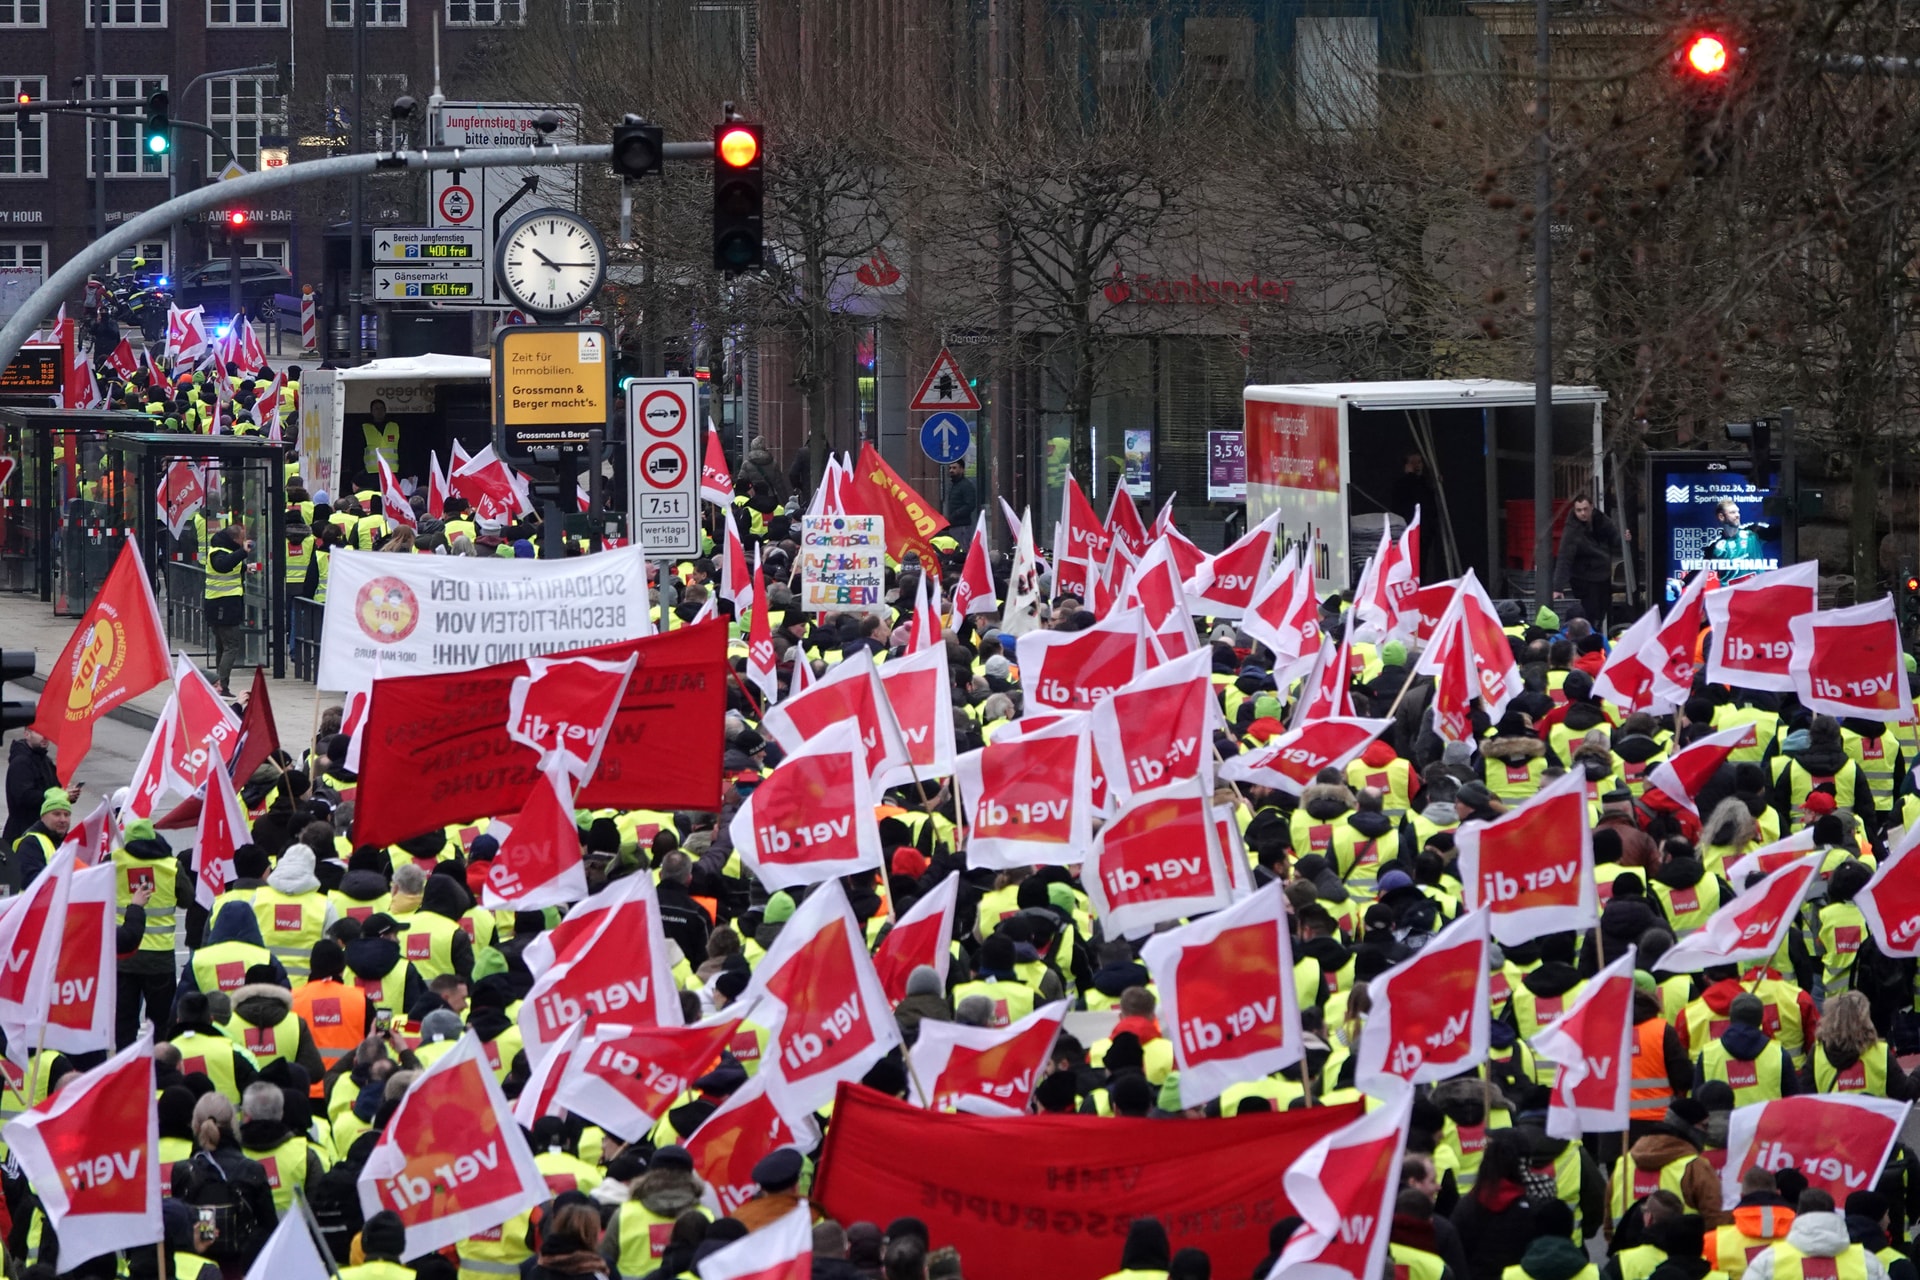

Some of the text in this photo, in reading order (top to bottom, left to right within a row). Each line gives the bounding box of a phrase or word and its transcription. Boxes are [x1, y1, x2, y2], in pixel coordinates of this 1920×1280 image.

[446, 115, 516, 130] Jungfernstieg
[465, 133, 539, 145] bitte einordne
[12, 210, 43, 223] HOUR
[208, 209, 264, 222] AMECAN
[270, 209, 292, 222] BAR
[393, 233, 465, 244] Bereich Jungfernstieg
[429, 245, 467, 257] 400 frei
[394, 271, 449, 281] Gänsemarkt
[431, 283, 467, 295] 150 frei
[1135, 273, 1297, 305] Santander
[512, 352, 552, 362] Zeit für
[512, 365, 574, 376] Immobilien.
[512, 384, 584, 395] Grossmann &
[512, 398, 597, 410] Berger macht's.
[516, 430, 590, 440] Grossmann & Berge
[1694, 494, 1733, 504] Sporthalle
[650, 498, 671, 514] 7,5
[644, 526, 686, 535] werktags
[652, 536, 674, 544] 11-18
[1072, 525, 1110, 551] ver.
[810, 586, 878, 606] LEBEN
[1740, 738, 1756, 746] er.di
[1674, 901, 1698, 910] ver.di
[276, 920, 301, 929] ver.di
[1837, 941, 1860, 950] ver.di
[408, 948, 430, 957] ver.di
[314, 1014, 341, 1023] ver.di
[732, 1048, 758, 1058] ver.di
[1730, 1075, 1756, 1084] ver.di
[1838, 1077, 1864, 1086] ver.di
